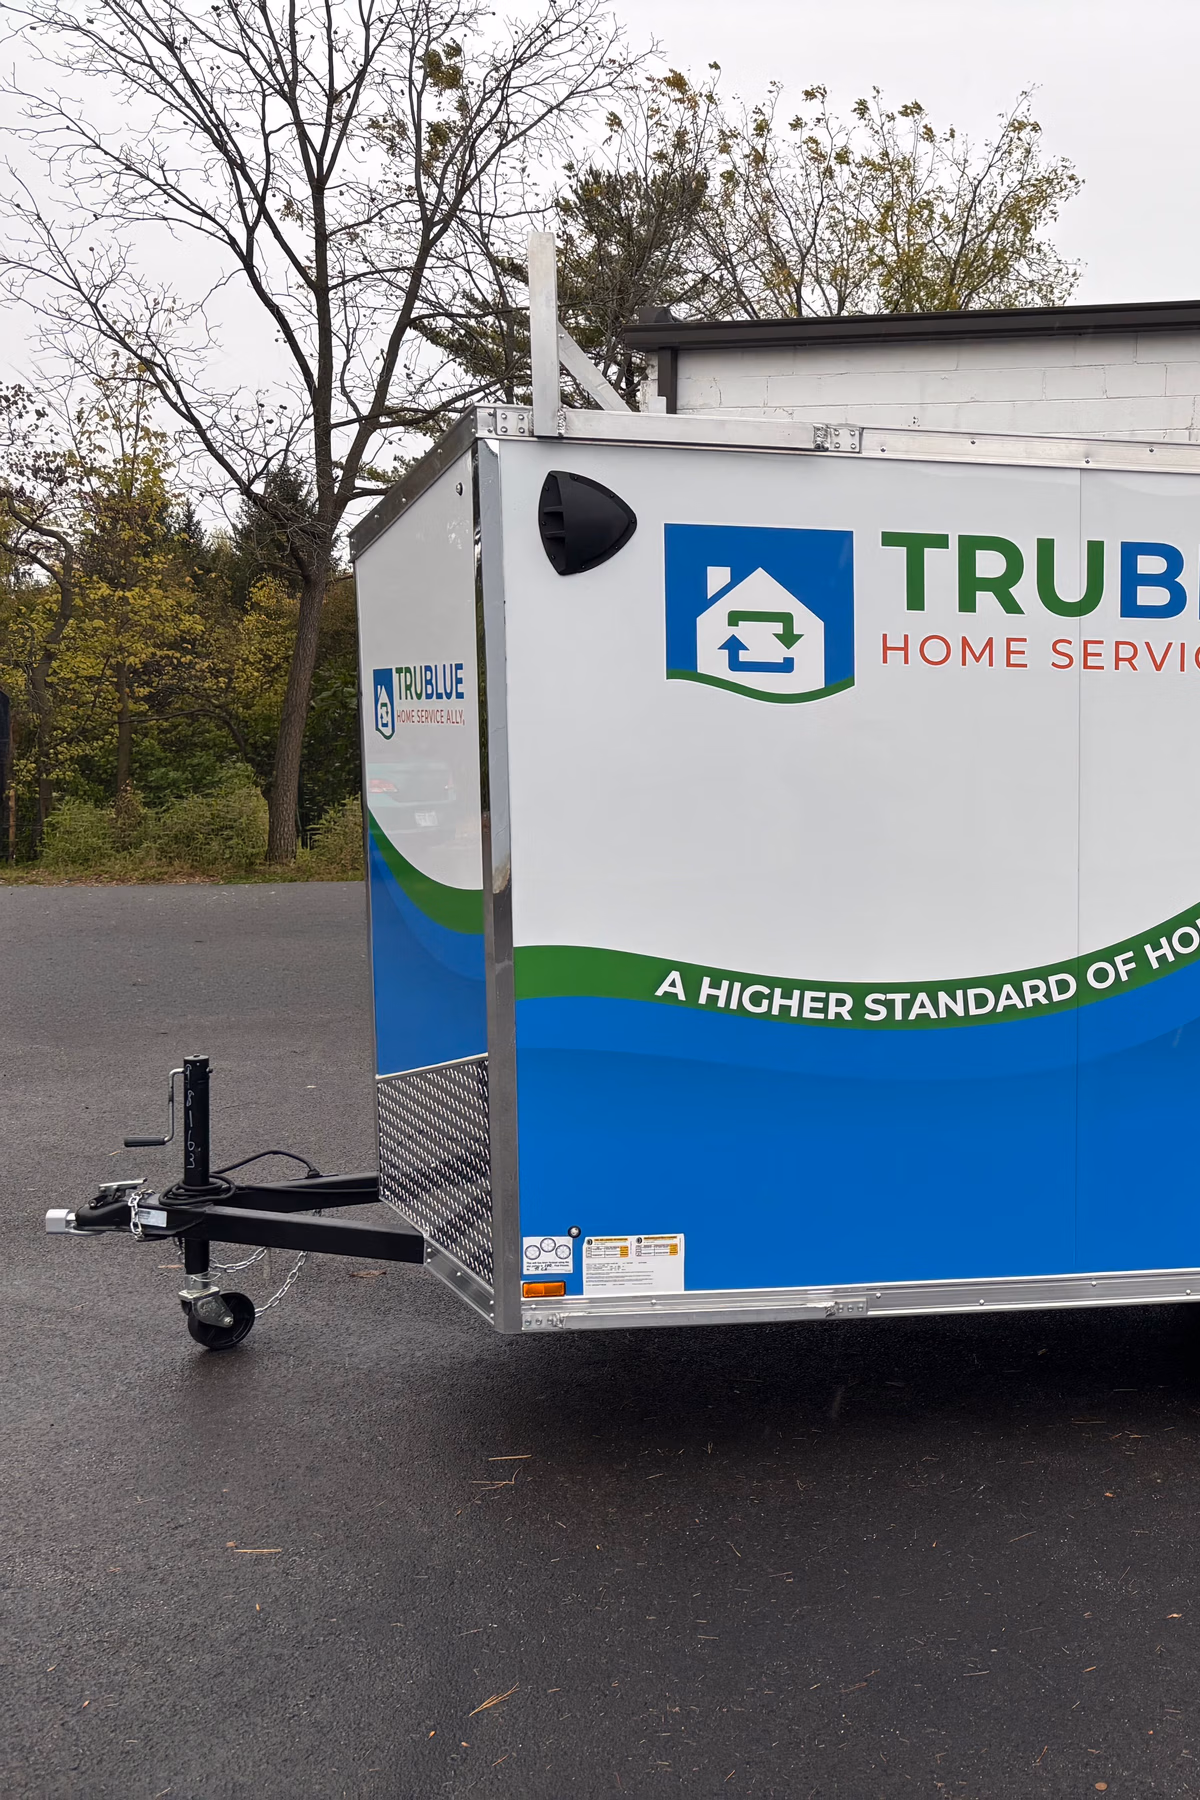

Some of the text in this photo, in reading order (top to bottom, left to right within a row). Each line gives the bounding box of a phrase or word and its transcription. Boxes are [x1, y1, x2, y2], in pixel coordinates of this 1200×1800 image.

[882, 633, 1028, 669] HOME
[395, 663, 465, 700] TRUBLUE
[396, 709, 415, 723] HOME
[416, 709, 444, 724] SERVICE
[654, 970, 687, 1001] A
[697, 976, 854, 1021] HIGHER
[863, 973, 1077, 1022] STANDARD
[1086, 950, 1137, 990] OF
